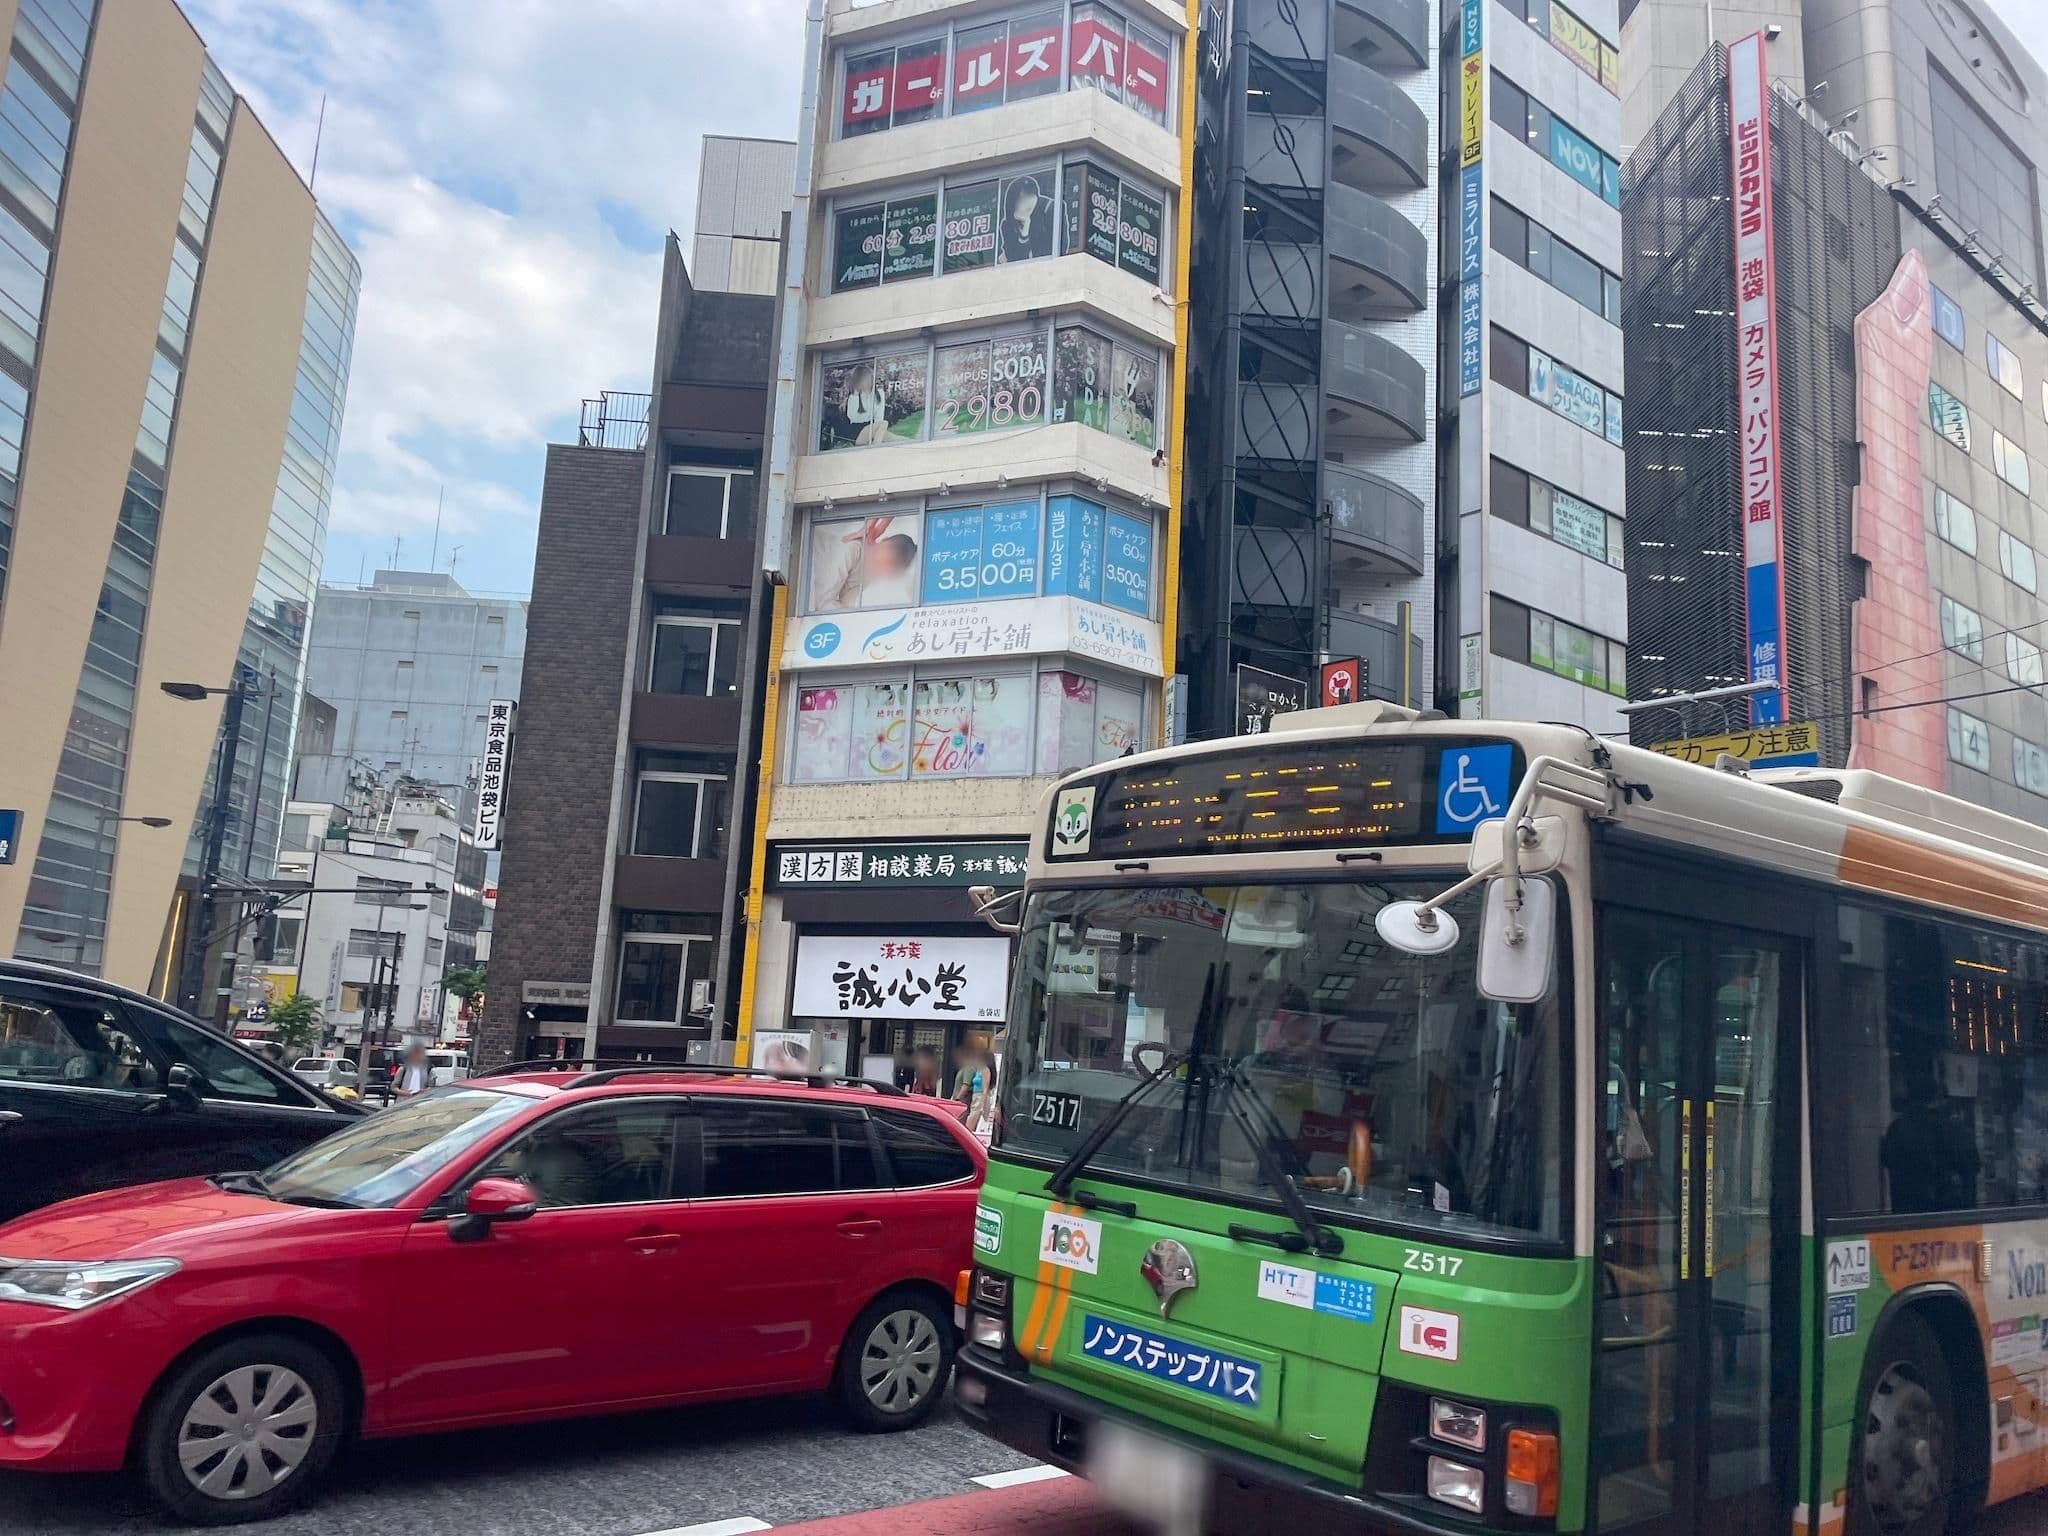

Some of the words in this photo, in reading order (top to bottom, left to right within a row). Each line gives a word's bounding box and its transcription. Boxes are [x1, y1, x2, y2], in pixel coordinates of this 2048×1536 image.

[1468, 6, 1478, 49] NOVA
[852, 33, 1157, 114] ガールズバー
[1127, 75, 1138, 88] 6F
[930, 86, 943, 99] 6F
[1467, 80, 1478, 142] ソレイユ
[1558, 135, 1611, 193] NOVA
[1738, 117, 1761, 238] ビックカメラ
[862, 228, 904, 254] 60分
[909, 214, 991, 245] 2,980円
[1464, 183, 1479, 271] ミライアス
[1742, 258, 1764, 302] 池袋
[1463, 284, 1480, 365] 株式会社
[992, 353, 1046, 382] SODA
[888, 377, 925, 393] FRESH
[1574, 382, 1600, 411] AGA
[1745, 325, 1771, 523] カメラ・パソコン館
[1050, 510, 1065, 581] 当ビル3F
[1109, 526, 1147, 545] ボディケア
[932, 548, 979, 563] ボディケア
[992, 542, 1025, 558] 60分
[1123, 543, 1146, 562] 60分
[938, 562, 1034, 590] 3,500円
[1106, 564, 1147, 591] 3,500円
[912, 615, 988, 629] relaxation
[809, 631, 836, 649] 3F
[478, 705, 509, 842] 東京食品池袋ビル
[782, 855, 861, 880] 漢方薬
[867, 854, 956, 878] 相談薬局
[962, 858, 994, 873] 漢方薬
[880, 941, 922, 960] 漢方薬
[832, 961, 967, 1011] 誠心堂
[977, 1008, 1001, 1018] 池袋店
[1033, 1094, 1079, 1126] Z517
[1404, 1249, 1463, 1276] Z517
[1843, 1246, 1866, 1270] 入口
[1265, 1267, 1298, 1287] HTT
[1085, 1324, 1257, 1402] ノンステップバス
